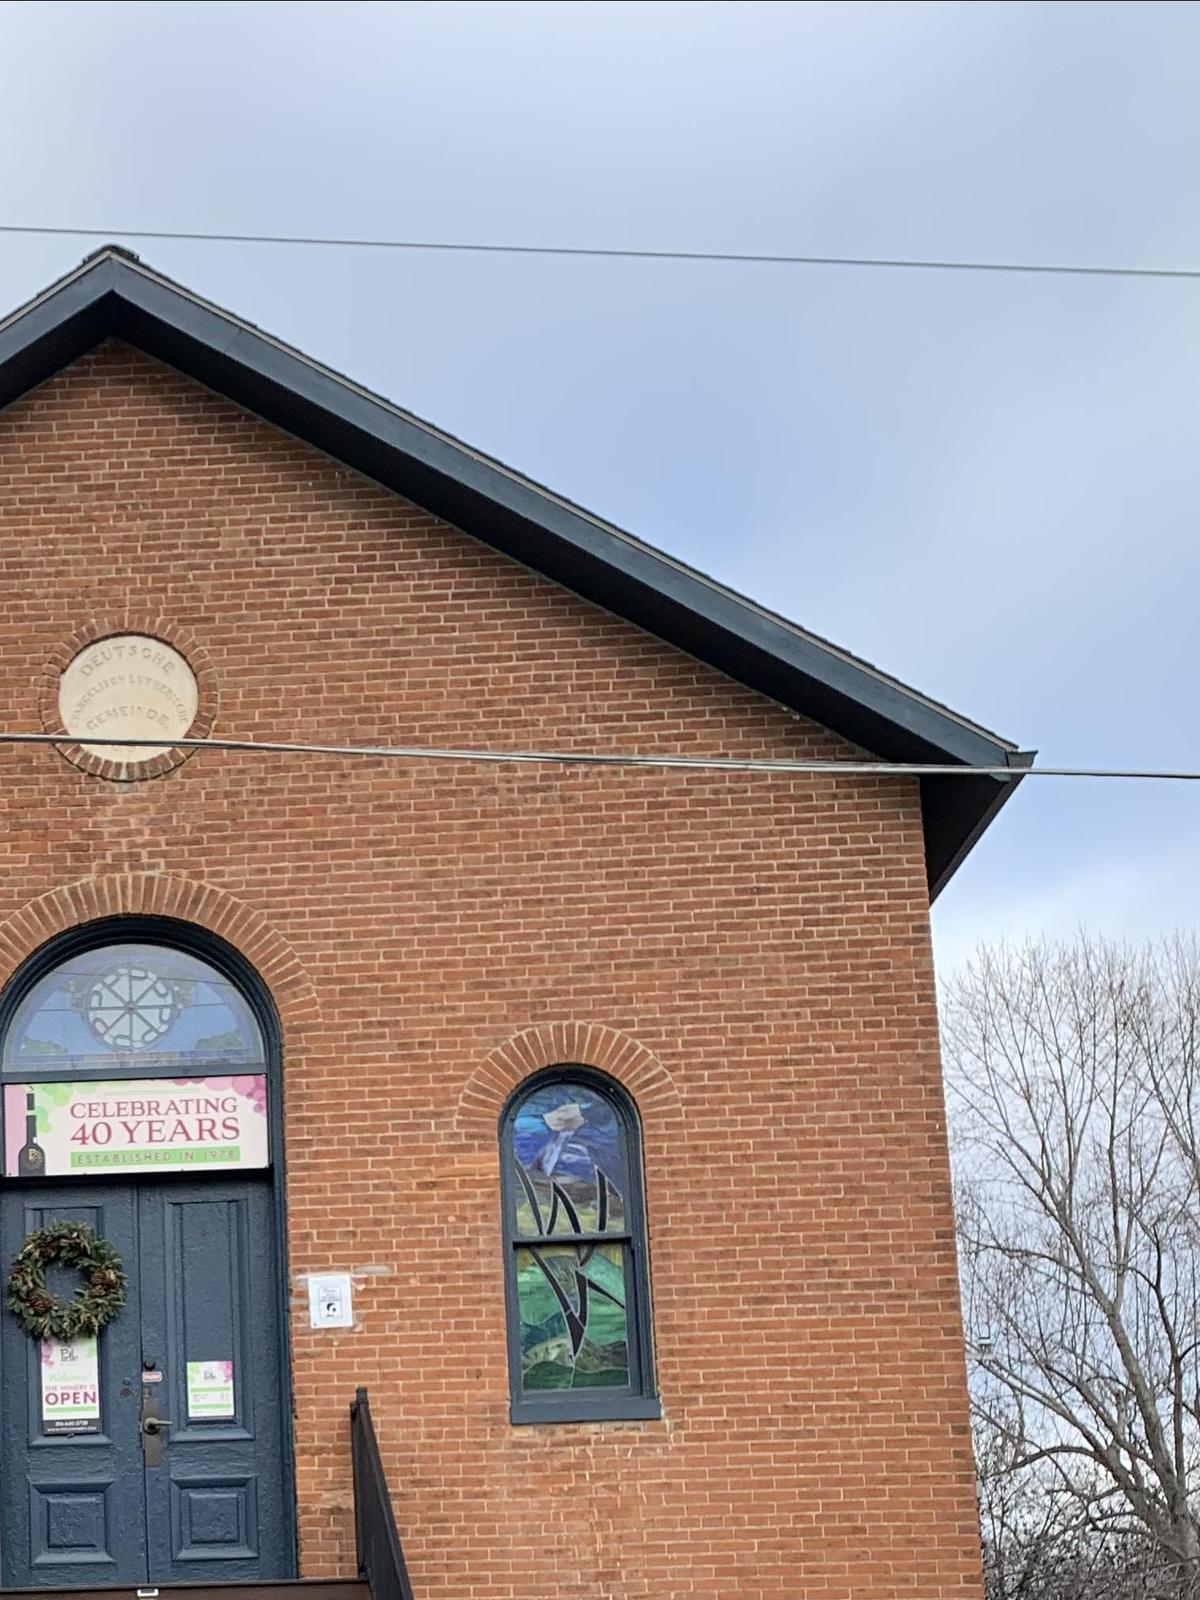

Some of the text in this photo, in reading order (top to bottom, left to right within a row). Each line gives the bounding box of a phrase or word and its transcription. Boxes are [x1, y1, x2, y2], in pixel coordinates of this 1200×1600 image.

[70, 1096, 238, 1119] CELEBRATING
[70, 1116, 241, 1146] 40 YEARS
[77, 1149, 236, 1166] ESTABLISHED IN 1978
[44, 1391, 97, 1406] OPEN
